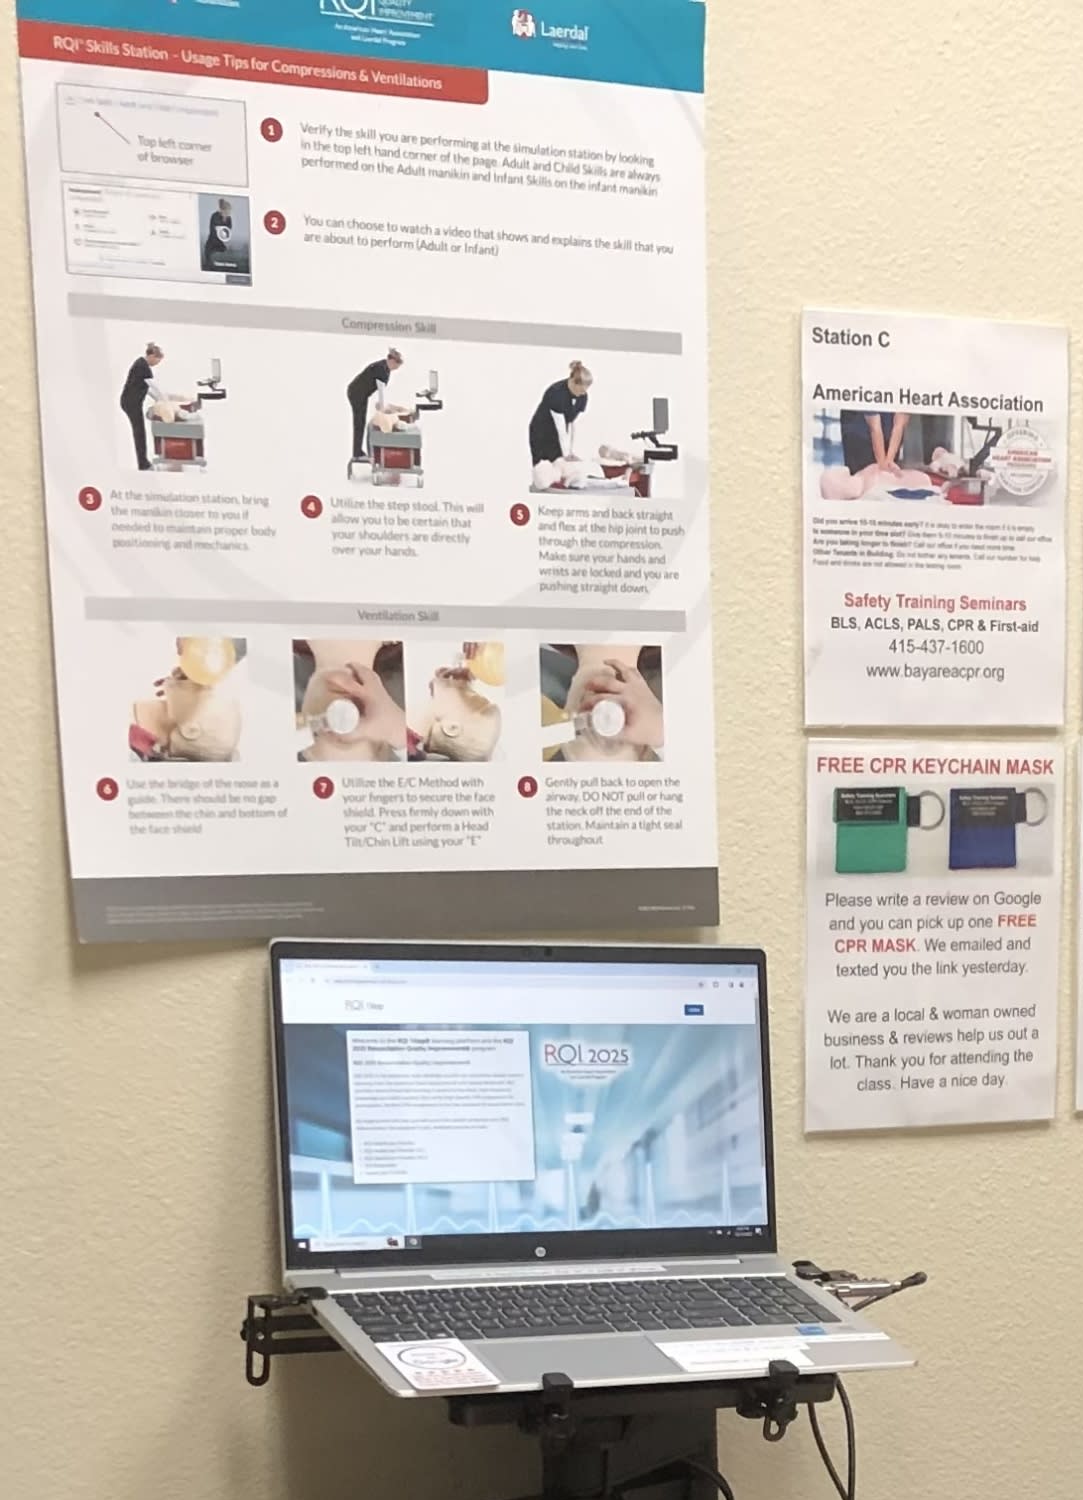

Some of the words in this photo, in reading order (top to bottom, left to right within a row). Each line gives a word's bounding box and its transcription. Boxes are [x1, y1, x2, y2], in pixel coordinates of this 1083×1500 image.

[122, 43, 169, 60] Station
[358, 69, 369, 82] &
[303, 214, 324, 227] You
[325, 219, 345, 228] can
[346, 218, 385, 232] choose
[386, 221, 398, 233] to
[400, 224, 433, 235] watch
[434, 228, 441, 236] a
[442, 226, 472, 239] video
[473, 228, 495, 240] that
[496, 229, 529, 243] shows
[531, 233, 550, 245] and
[551, 235, 592, 248] explains
[594, 238, 611, 250] the
[613, 239, 632, 251] skill
[634, 241, 654, 253] that
[656, 245, 674, 255] you
[304, 233, 322, 243] are
[323, 232, 354, 245] about
[357, 235, 369, 247] to
[370, 237, 414, 250] perform
[416, 238, 448, 252] (Adult
[450, 245, 462, 253] or
[464, 242, 499, 257] Infant)
[812, 326, 872, 347] Station
[878, 331, 890, 348] C
[812, 383, 893, 404] American
[899, 388, 943, 407] Heart
[948, 391, 1043, 413] Association
[844, 592, 892, 611] Safety
[895, 593, 955, 612] Training
[960, 595, 1027, 611] Seminars
[947, 618, 974, 631] CPR
[977, 619, 986, 632] &
[990, 619, 1039, 632] First-aid
[888, 638, 984, 655] 415-437-1600
[866, 663, 1005, 683] www.bayareacpr.org
[817, 756, 864, 774] FREE
[870, 757, 907, 774] CPR
[912, 758, 1001, 775] KEYCHAIN
[1006, 759, 1054, 775] MASK
[825, 892, 873, 907] Please
[876, 893, 909, 907] write
[913, 895, 921, 906] a
[925, 892, 970, 906] review
[972, 894, 990, 906] on
[994, 891, 1042, 909] Google
[829, 916, 855, 931] and
[859, 919, 884, 934] you
[888, 918, 912, 930] can
[917, 915, 944, 932] pick
[947, 917, 964, 932] up
[968, 917, 993, 929] one
[997, 914, 1037, 928] FREE
[834, 939, 867, 954] CPR
[924, 938, 946, 952] We
[950, 937, 1002, 952] emailed
[1006, 937, 1031, 951] and
[836, 962, 879, 977] texted
[882, 965, 907, 980] you
[911, 962, 932, 976] the
[936, 961, 958, 975] link
[961, 960, 1028, 977] yesterday.
[544, 1043, 582, 1066] RQI
[588, 1048, 629, 1063] 2025
